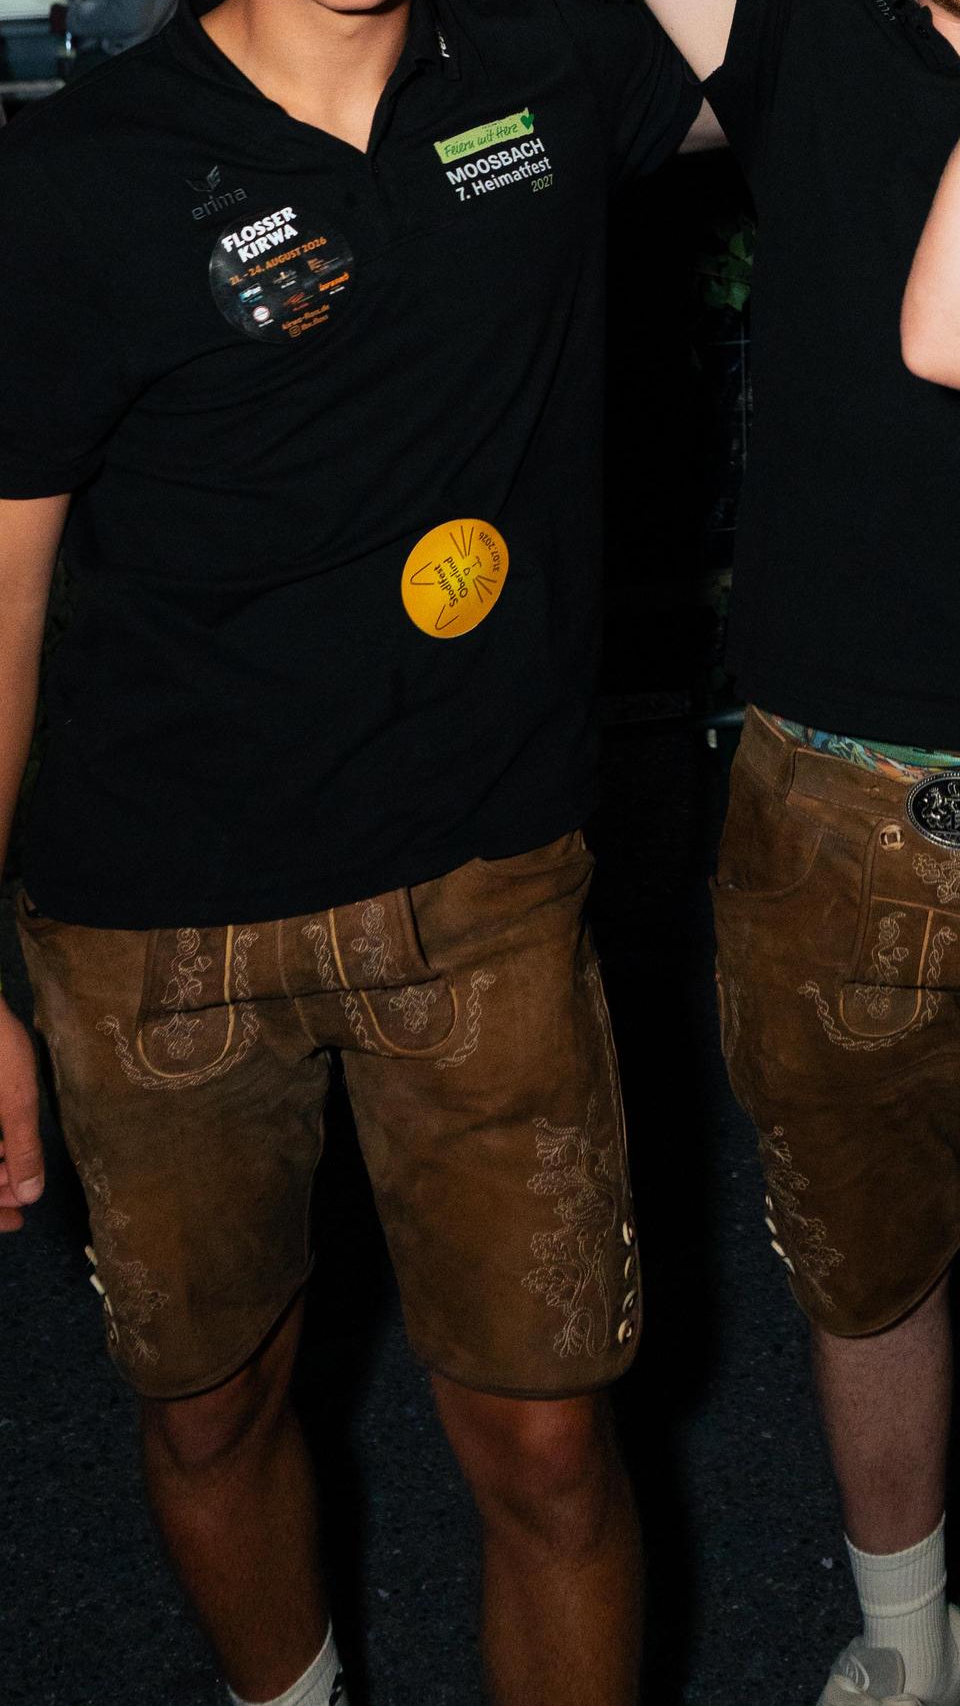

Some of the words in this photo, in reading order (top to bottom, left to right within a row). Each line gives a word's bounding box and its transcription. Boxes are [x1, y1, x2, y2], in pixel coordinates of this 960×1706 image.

[443, 140, 474, 158] Feiern
[496, 123, 519, 140] Herz
[445, 137, 545, 185] MOOSBACH
[455, 186, 471, 202] 7.
[472, 156, 552, 196] Heimatfest
[530, 174, 553, 193] 2027
[191, 188, 248, 221] erima
[221, 206, 297, 253] FLOSSER
[237, 224, 299, 263] KIRWA
[265, 247, 302, 270] AUGUST
[301, 236, 328, 254] 2026
[443, 555, 469, 599] Oberlind
